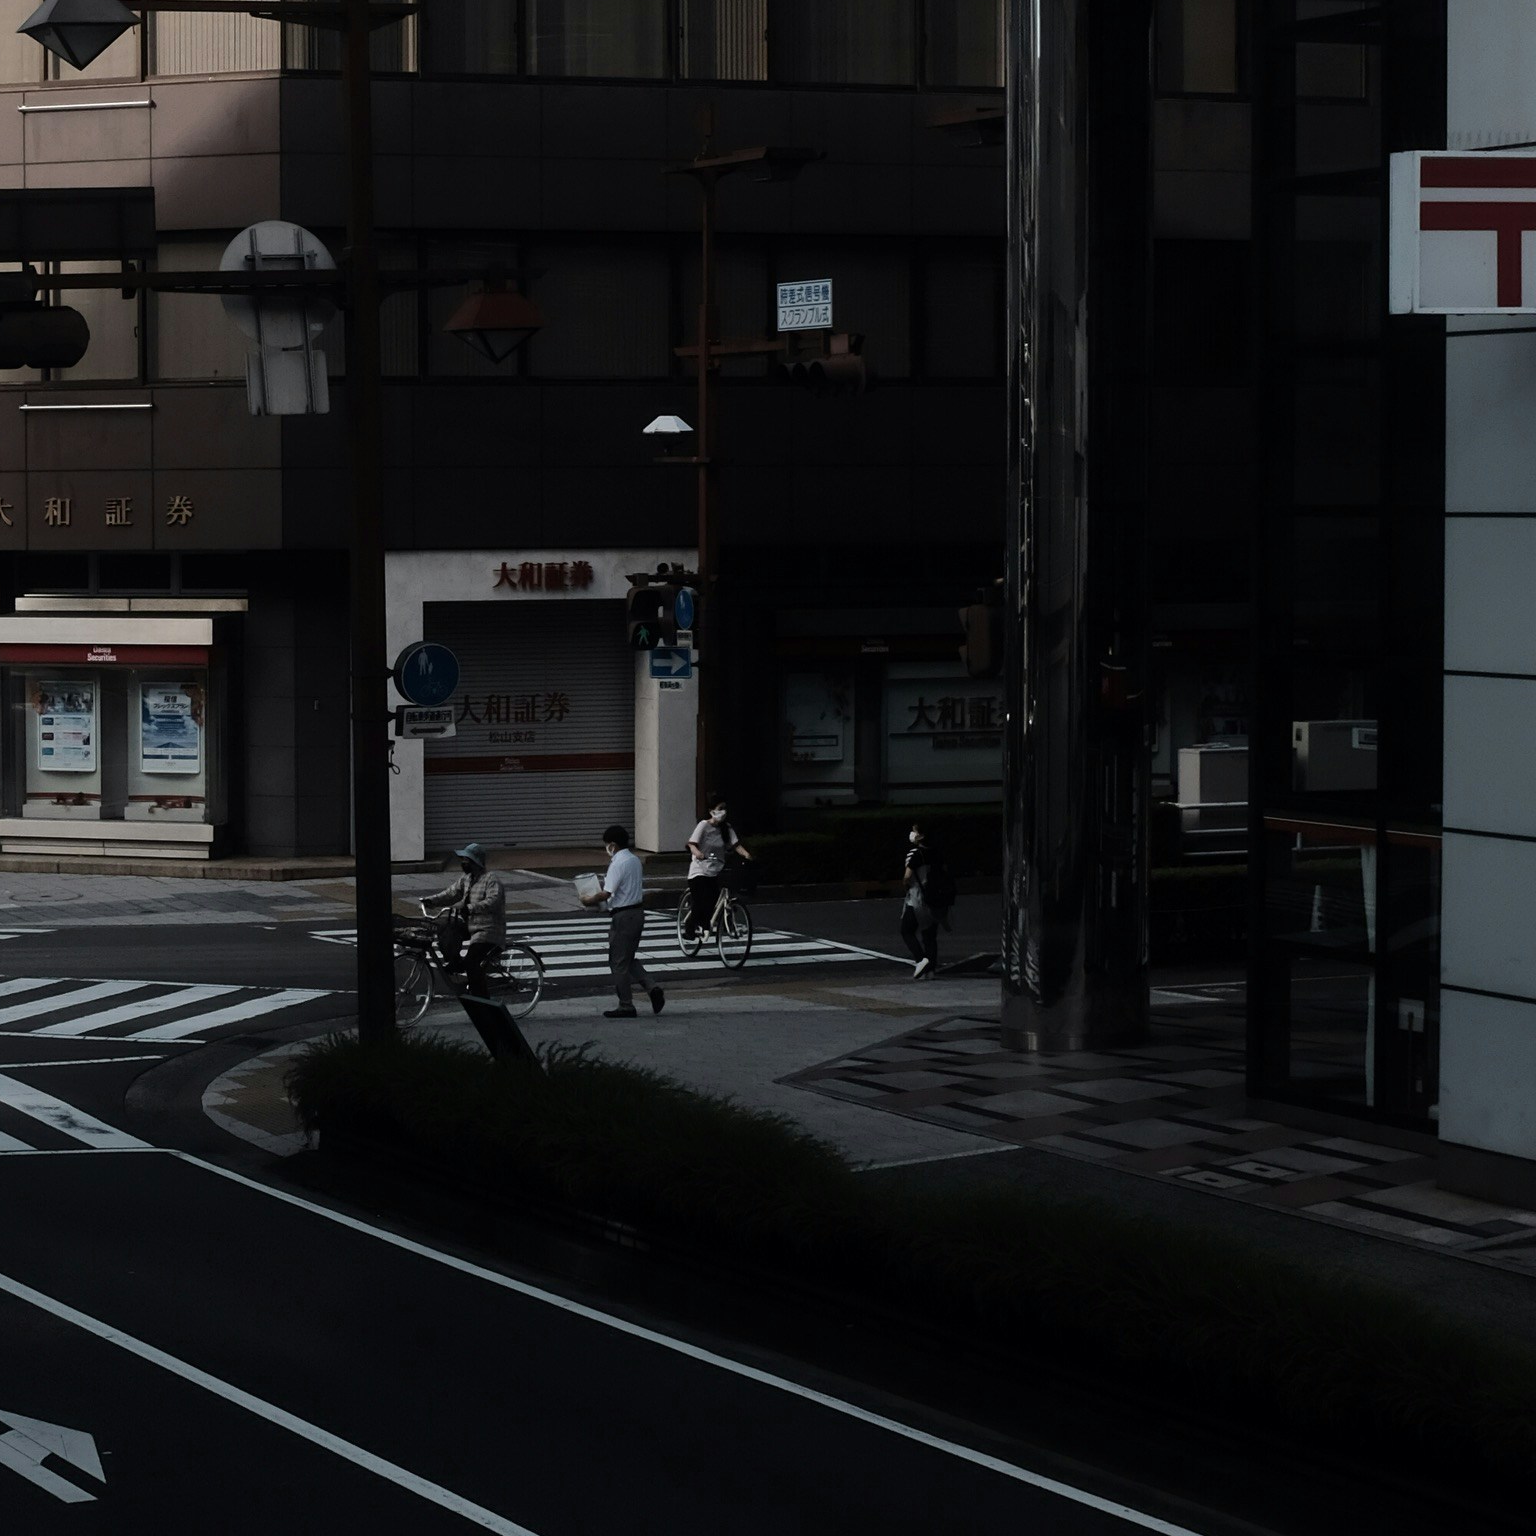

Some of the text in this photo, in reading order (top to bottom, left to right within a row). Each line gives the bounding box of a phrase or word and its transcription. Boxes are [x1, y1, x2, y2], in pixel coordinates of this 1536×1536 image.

[780, 285, 829, 304] 時差式信号機
[493, 561, 594, 590] 大和証券
[455, 692, 570, 724] 大和証券
[489, 731, 535, 743] 松山支店
